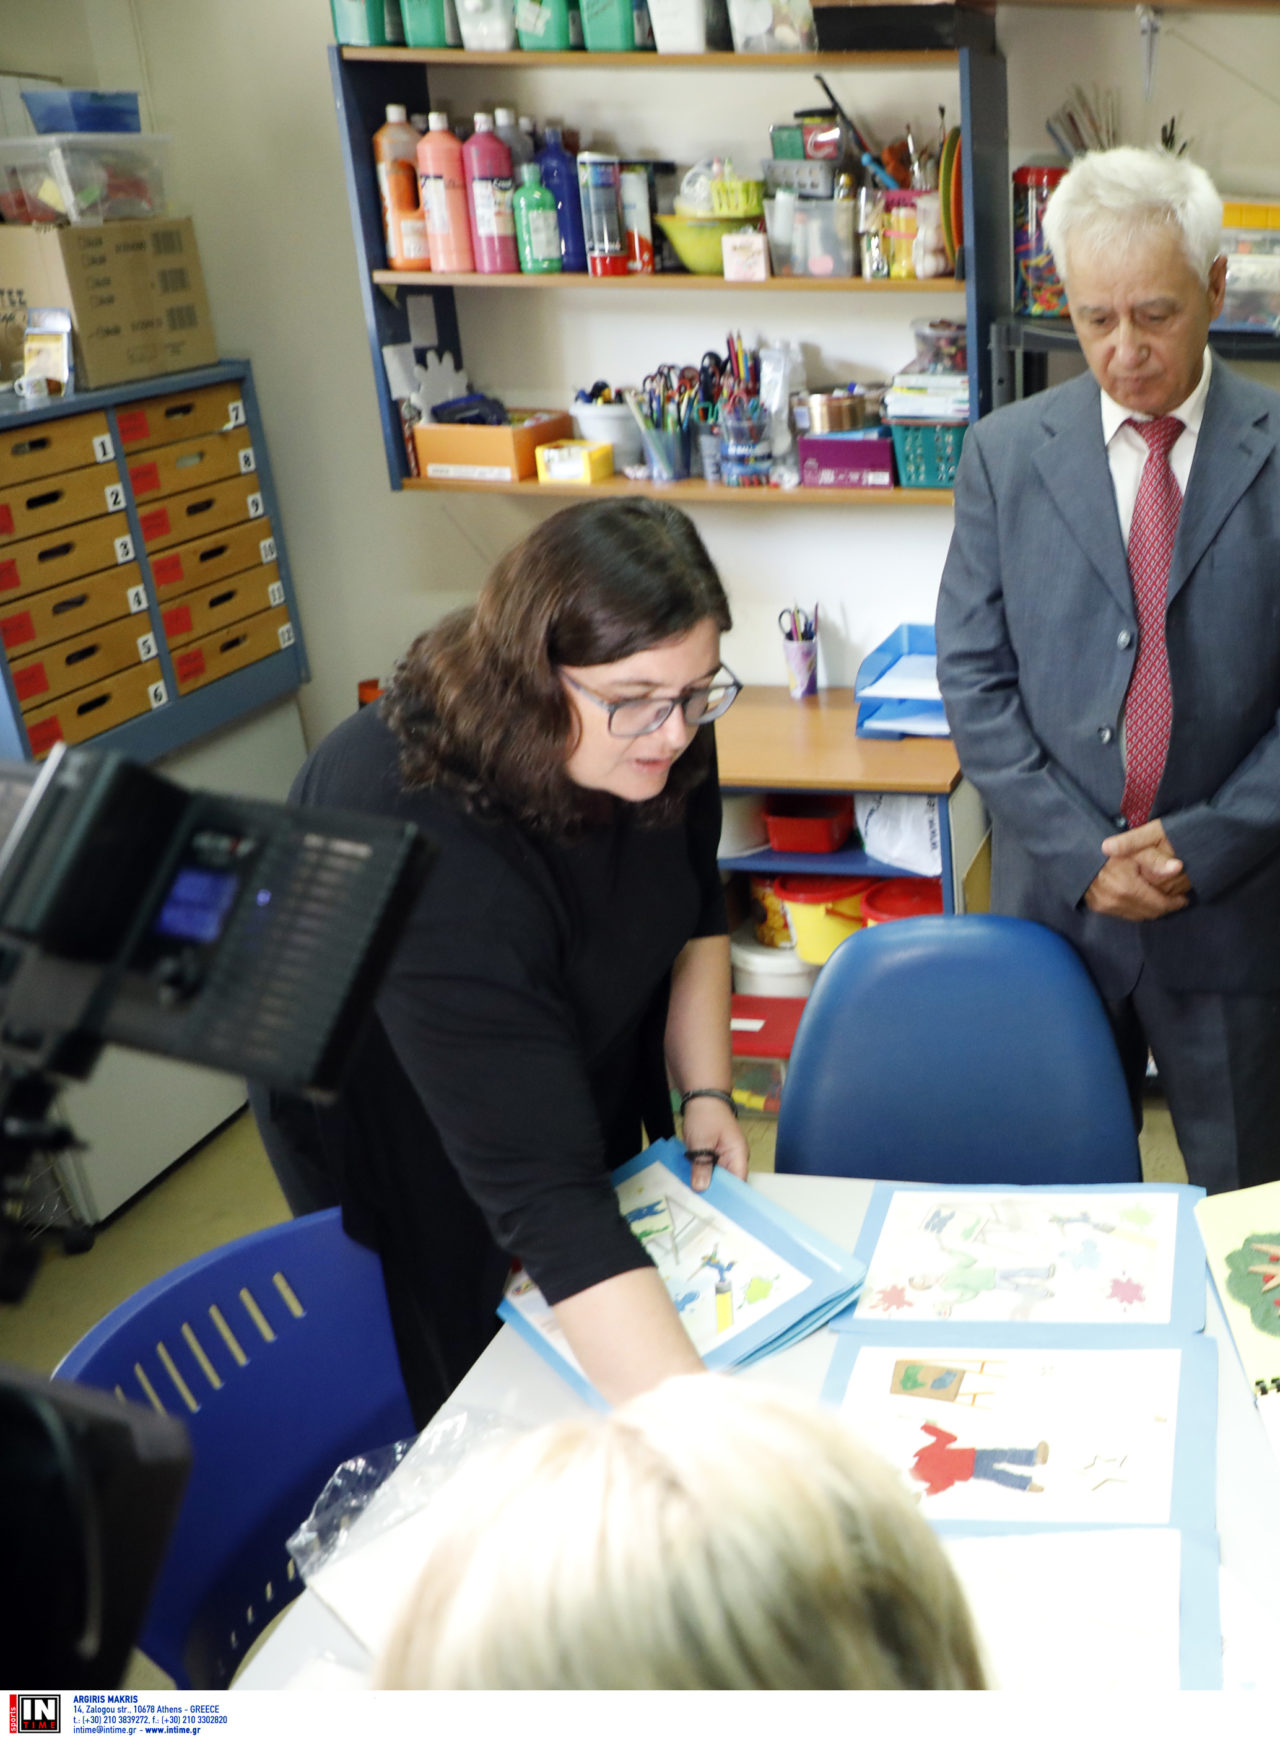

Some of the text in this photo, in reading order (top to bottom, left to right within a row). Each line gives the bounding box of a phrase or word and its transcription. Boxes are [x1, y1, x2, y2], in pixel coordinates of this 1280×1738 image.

[232, 405, 239, 422] 7
[100, 441, 108, 457] 1
[243, 454, 252, 468] 8
[110, 491, 121, 507] 2
[251, 498, 260, 513] 9
[120, 542, 130, 557] 3
[263, 541, 275, 557] 10
[133, 591, 142, 607] 4
[271, 585, 283, 600] 11
[280, 628, 292, 644] 12
[142, 639, 151, 655] 5
[153, 687, 163, 703] 6
